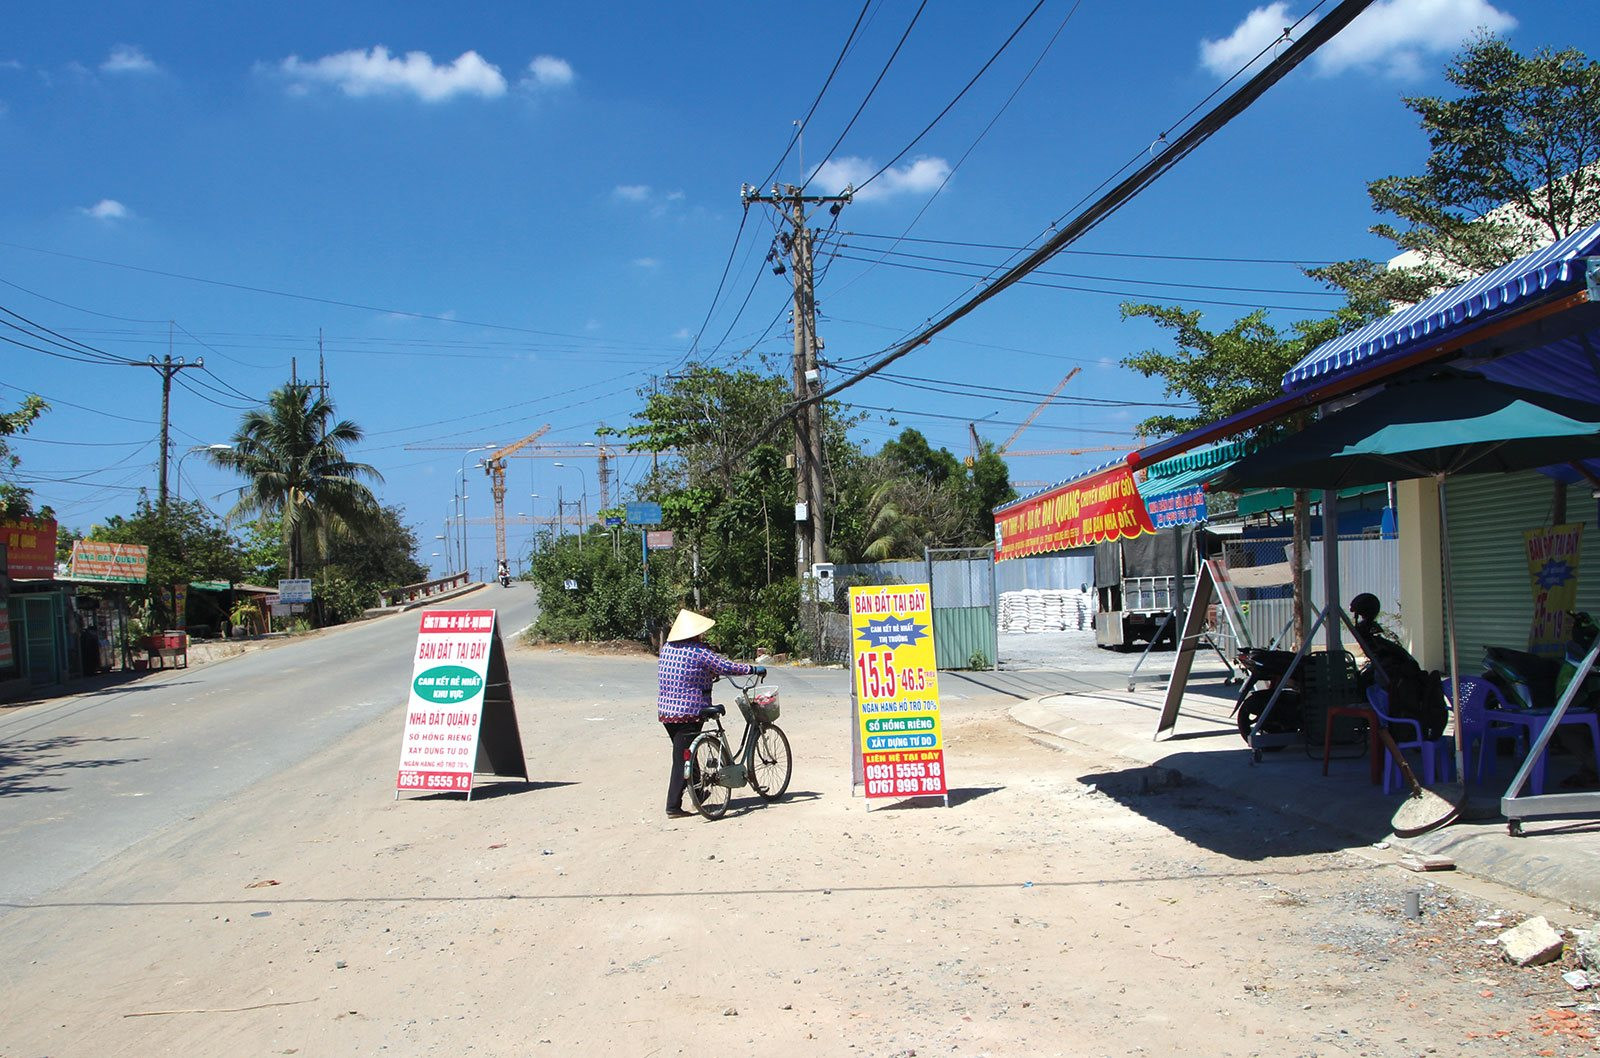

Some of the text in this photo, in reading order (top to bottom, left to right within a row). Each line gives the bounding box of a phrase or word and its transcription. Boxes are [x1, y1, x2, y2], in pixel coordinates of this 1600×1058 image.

[1042, 498, 1055, 532] ĐẠI
[1055, 488, 1080, 528] QUANG
[1104, 508, 1118, 531] NHÀ
[1118, 503, 1137, 529] ĐẤT
[855, 588, 926, 616] BÁN ĐẤT TẠI ĐÂY
[418, 678, 434, 686] CAM
[435, 676, 450, 686] KẾT
[461, 675, 481, 686] NHẤT
[858, 652, 896, 698] 15.5
[902, 668, 925, 691] 46.5
[433, 690, 448, 698] KHU
[923, 701, 937, 711] 70%
[472, 713, 478, 726] 9
[907, 718, 933, 729] RIÊNG
[871, 737, 886, 748] XÂY
[921, 736, 932, 745] DO
[866, 755, 886, 763] LIÊN
[888, 753, 901, 763] HỆ
[903, 753, 918, 762] TẠI
[866, 761, 941, 780] 0931 5555 18
[400, 774, 469, 788] 0931 5555 18
[868, 777, 942, 794] 0767 999 789
